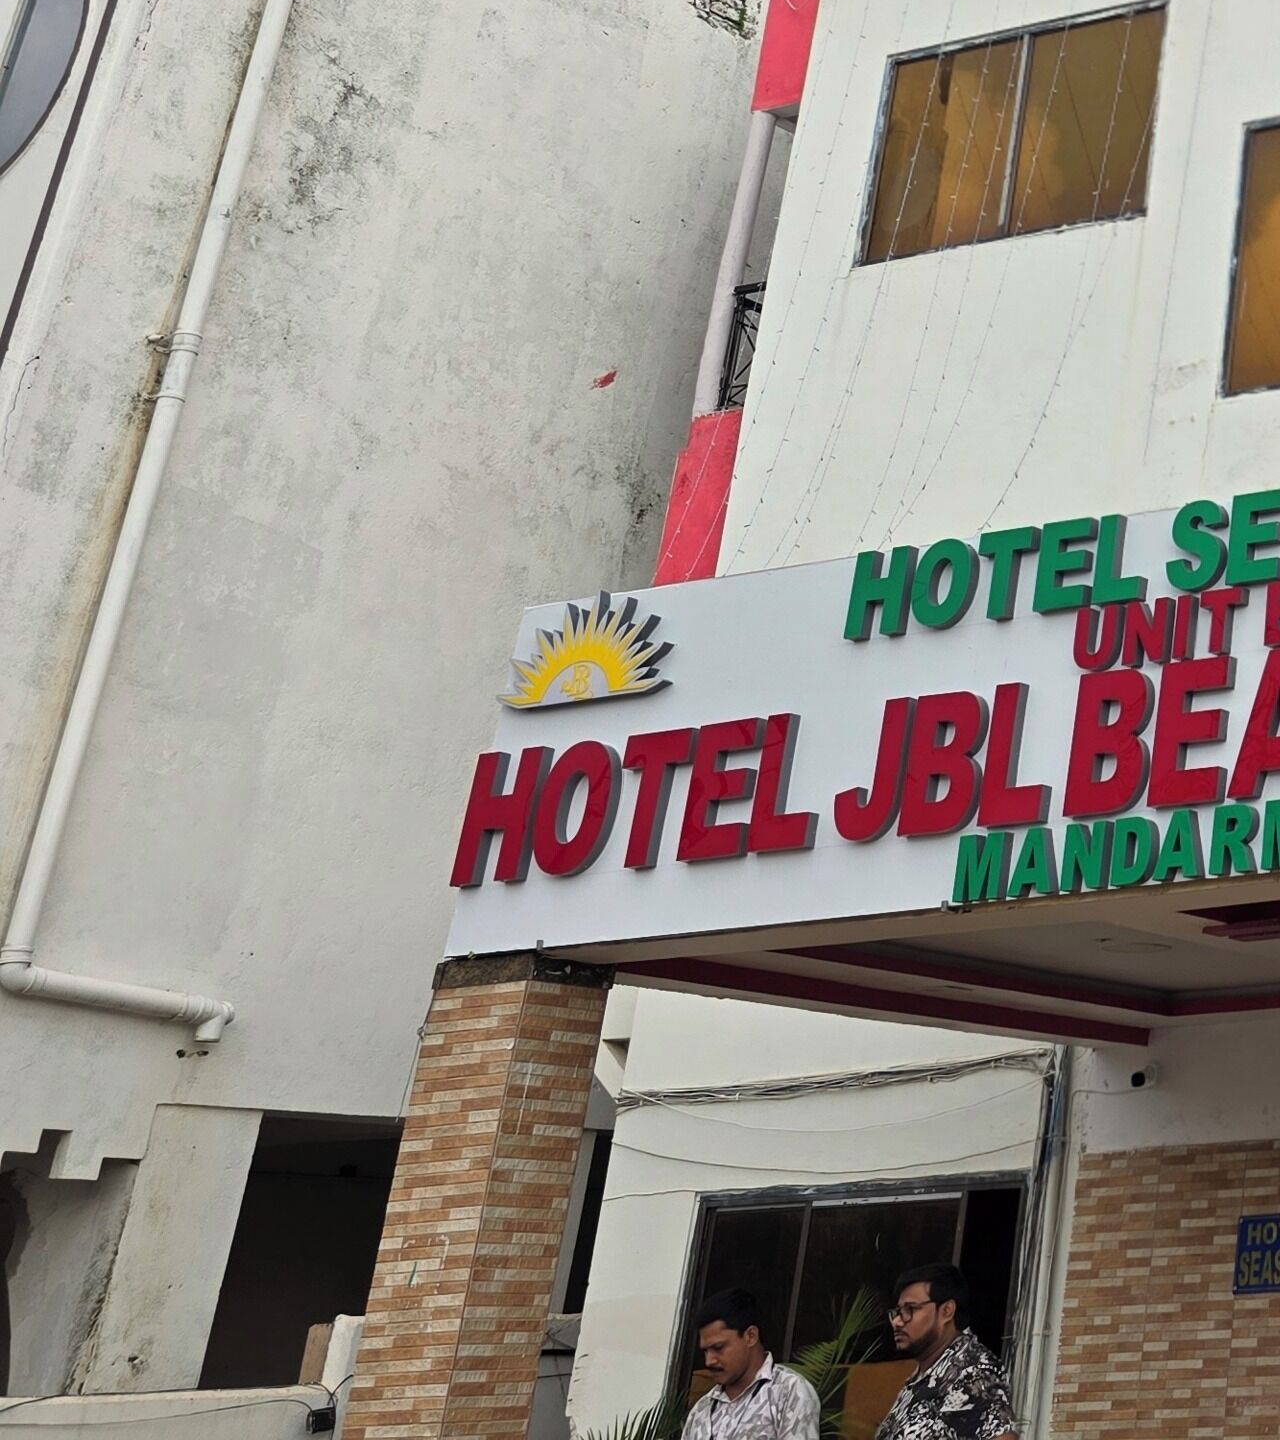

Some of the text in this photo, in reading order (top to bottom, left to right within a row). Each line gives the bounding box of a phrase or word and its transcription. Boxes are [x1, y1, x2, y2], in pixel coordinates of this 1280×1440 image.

[843, 514, 1147, 641] HOTEL
[1073, 587, 1247, 672] UNIT
[449, 712, 820, 887] HOTEL
[834, 682, 1051, 844] JBL
